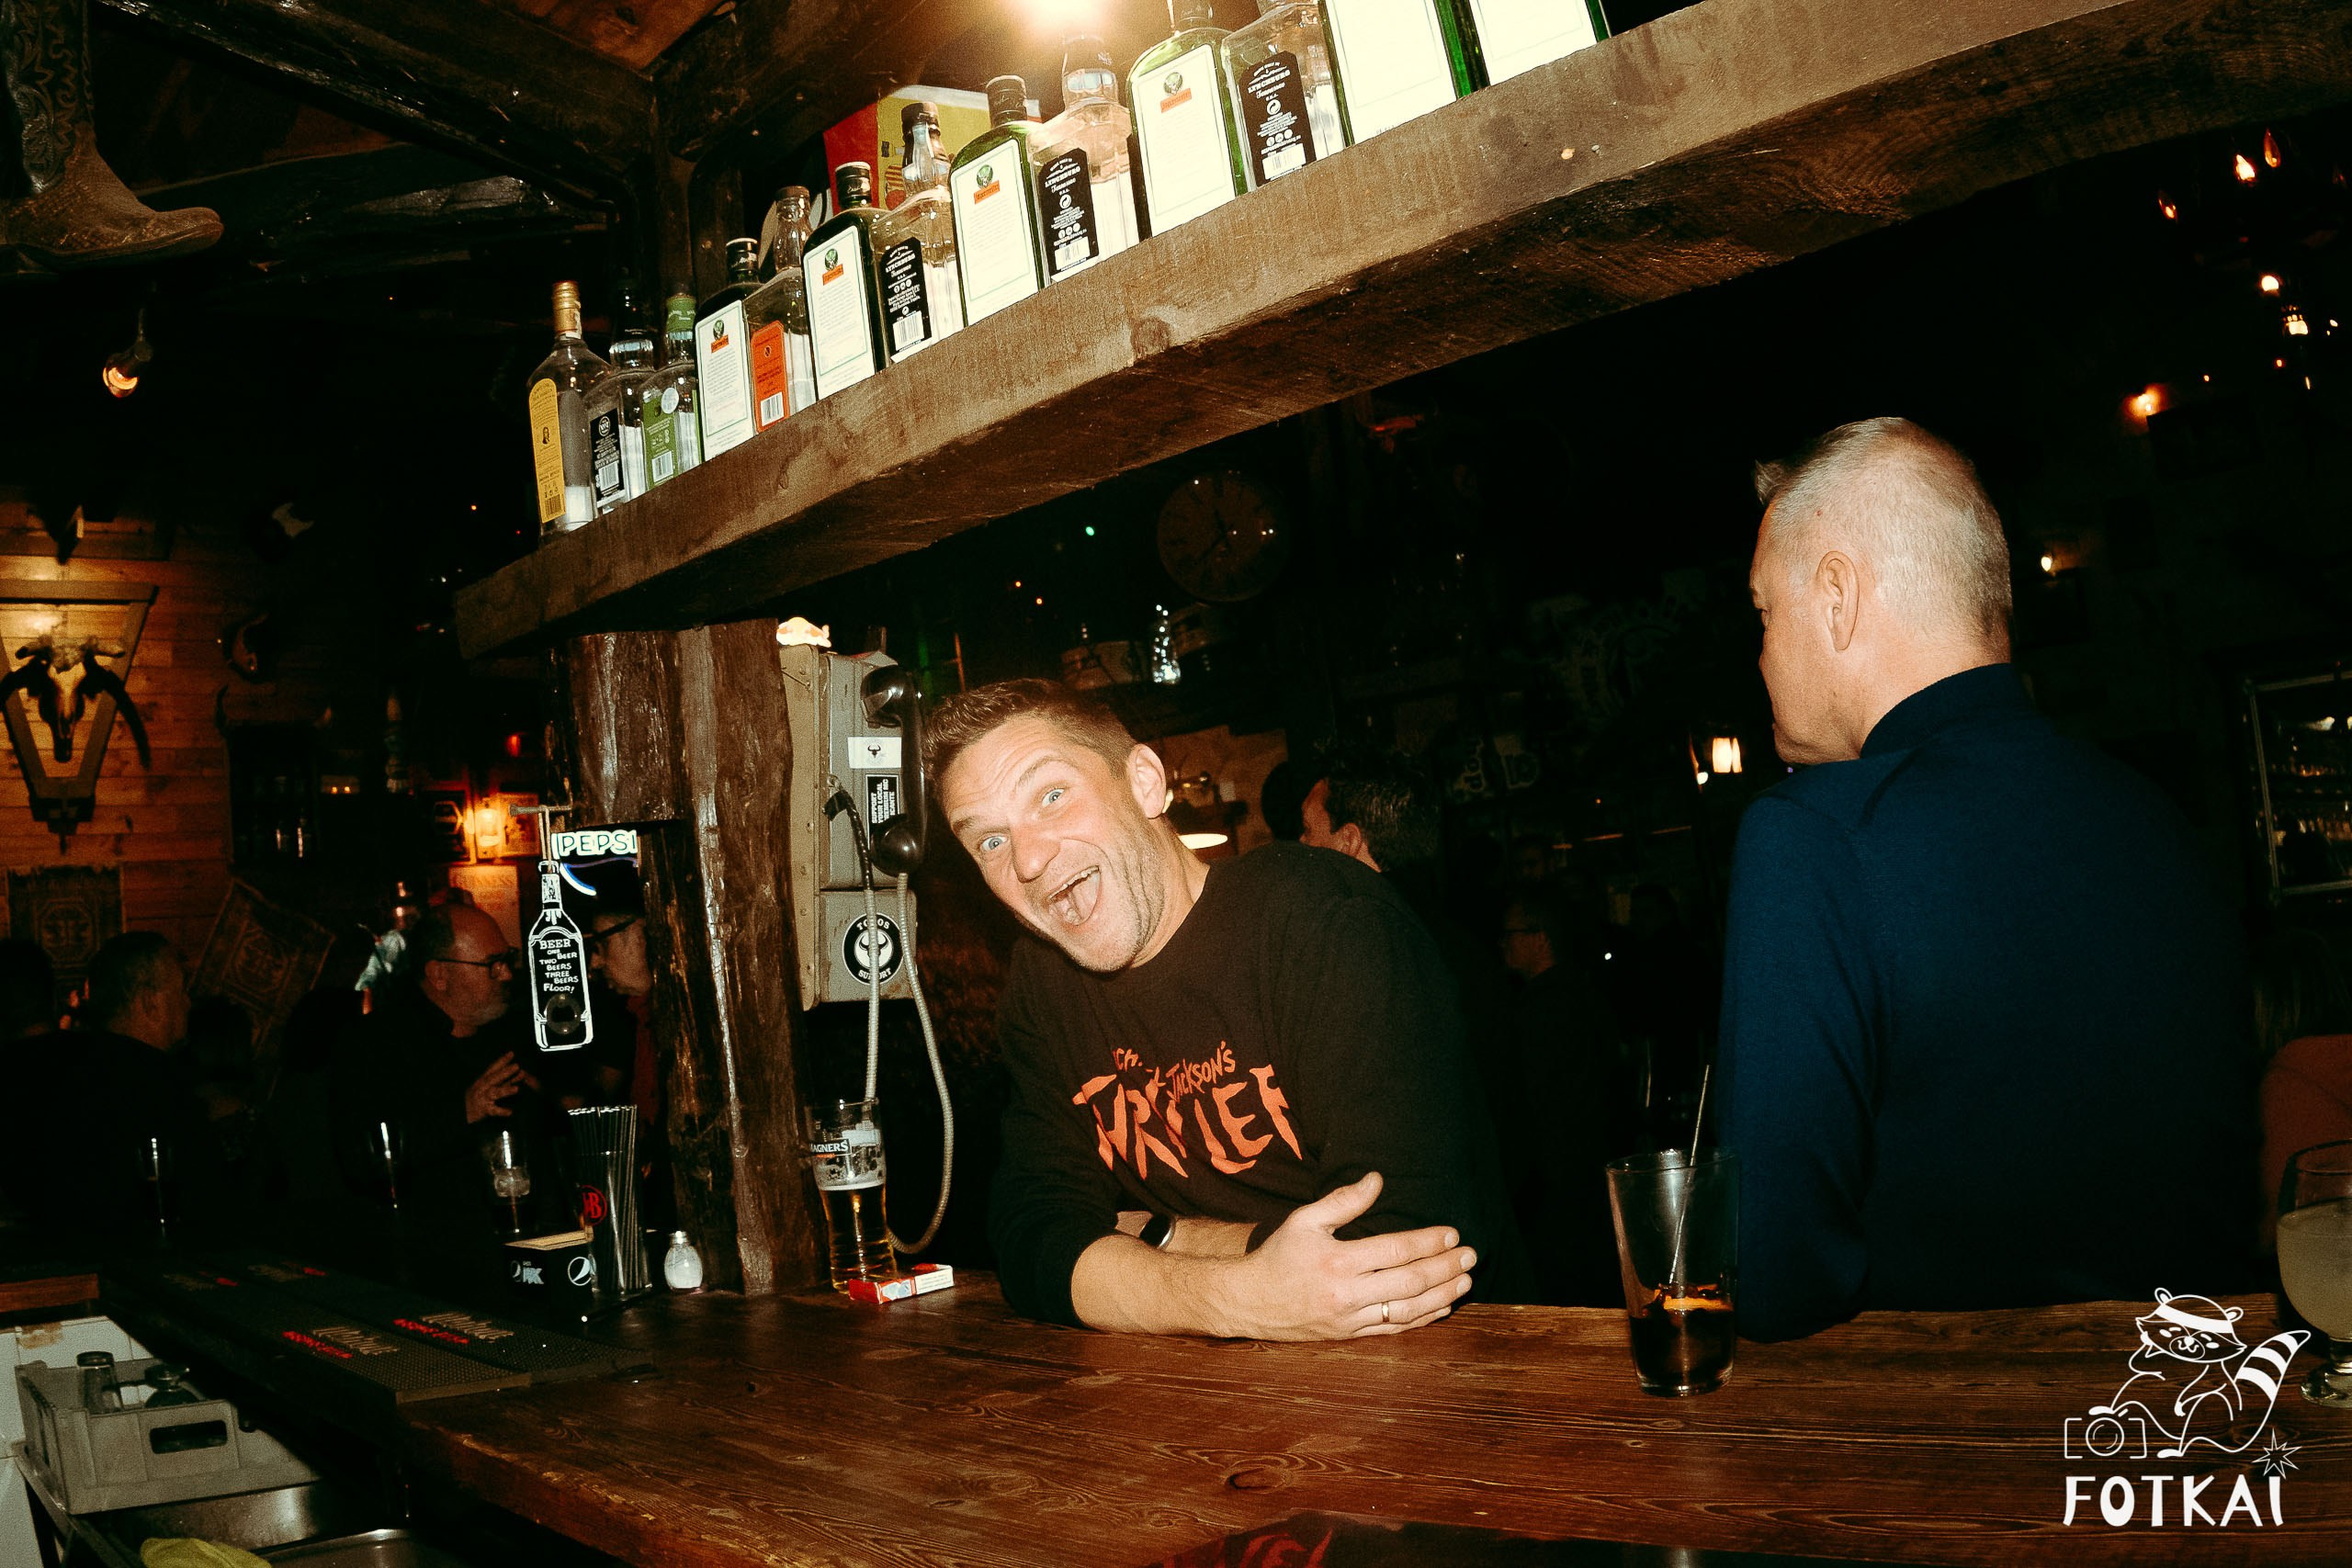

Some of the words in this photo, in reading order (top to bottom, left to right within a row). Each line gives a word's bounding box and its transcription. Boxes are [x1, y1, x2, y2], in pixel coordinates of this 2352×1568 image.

[559, 829, 638, 856] PEPSI
[856, 918, 890, 931] TOOS
[539, 938, 571, 950] BEER
[557, 952, 578, 960] BEER
[546, 963, 572, 971] BEERS
[858, 967, 892, 979] SURT
[545, 970, 570, 978] THREE
[553, 976, 579, 984] BEERS
[1165, 1040, 1236, 1102] JACKSON'S
